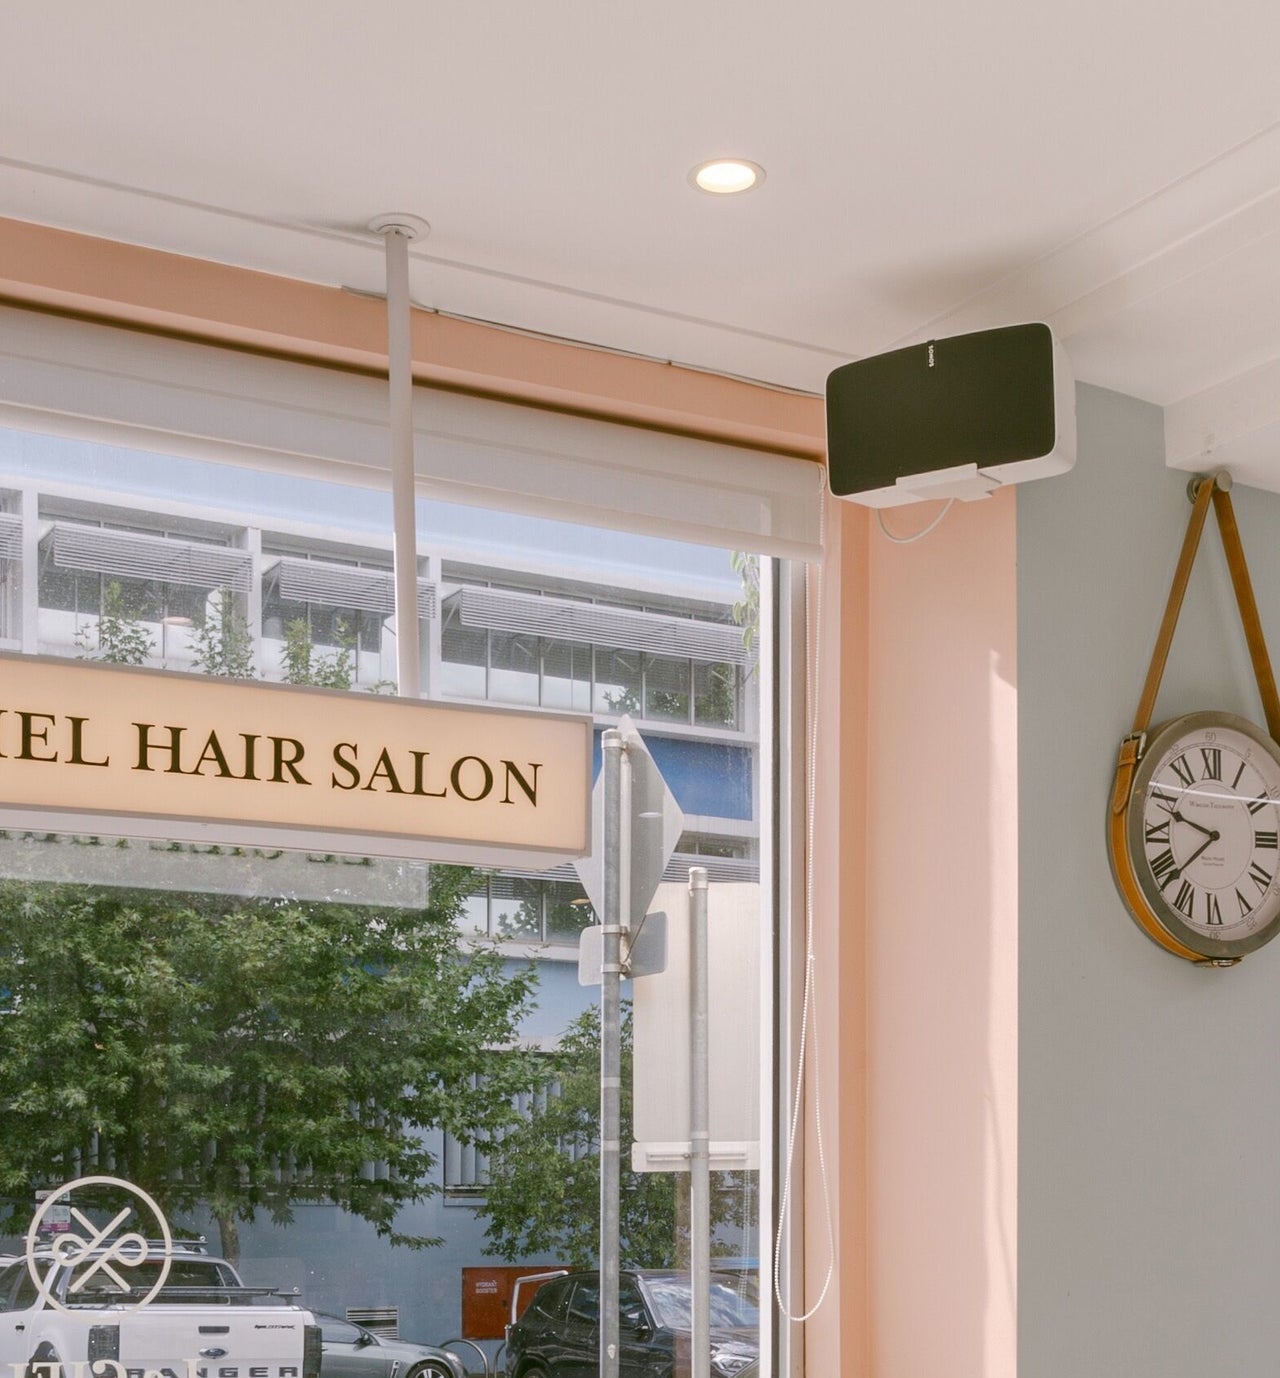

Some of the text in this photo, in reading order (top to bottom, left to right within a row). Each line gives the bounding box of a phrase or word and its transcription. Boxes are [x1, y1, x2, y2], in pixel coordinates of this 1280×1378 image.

[130, 721, 313, 786] HAIR
[331, 742, 544, 808] SALON
[1200, 748, 1222, 781] XII
[1254, 830, 1278, 849] III
[126, 1365, 298, 1378] RANGER
